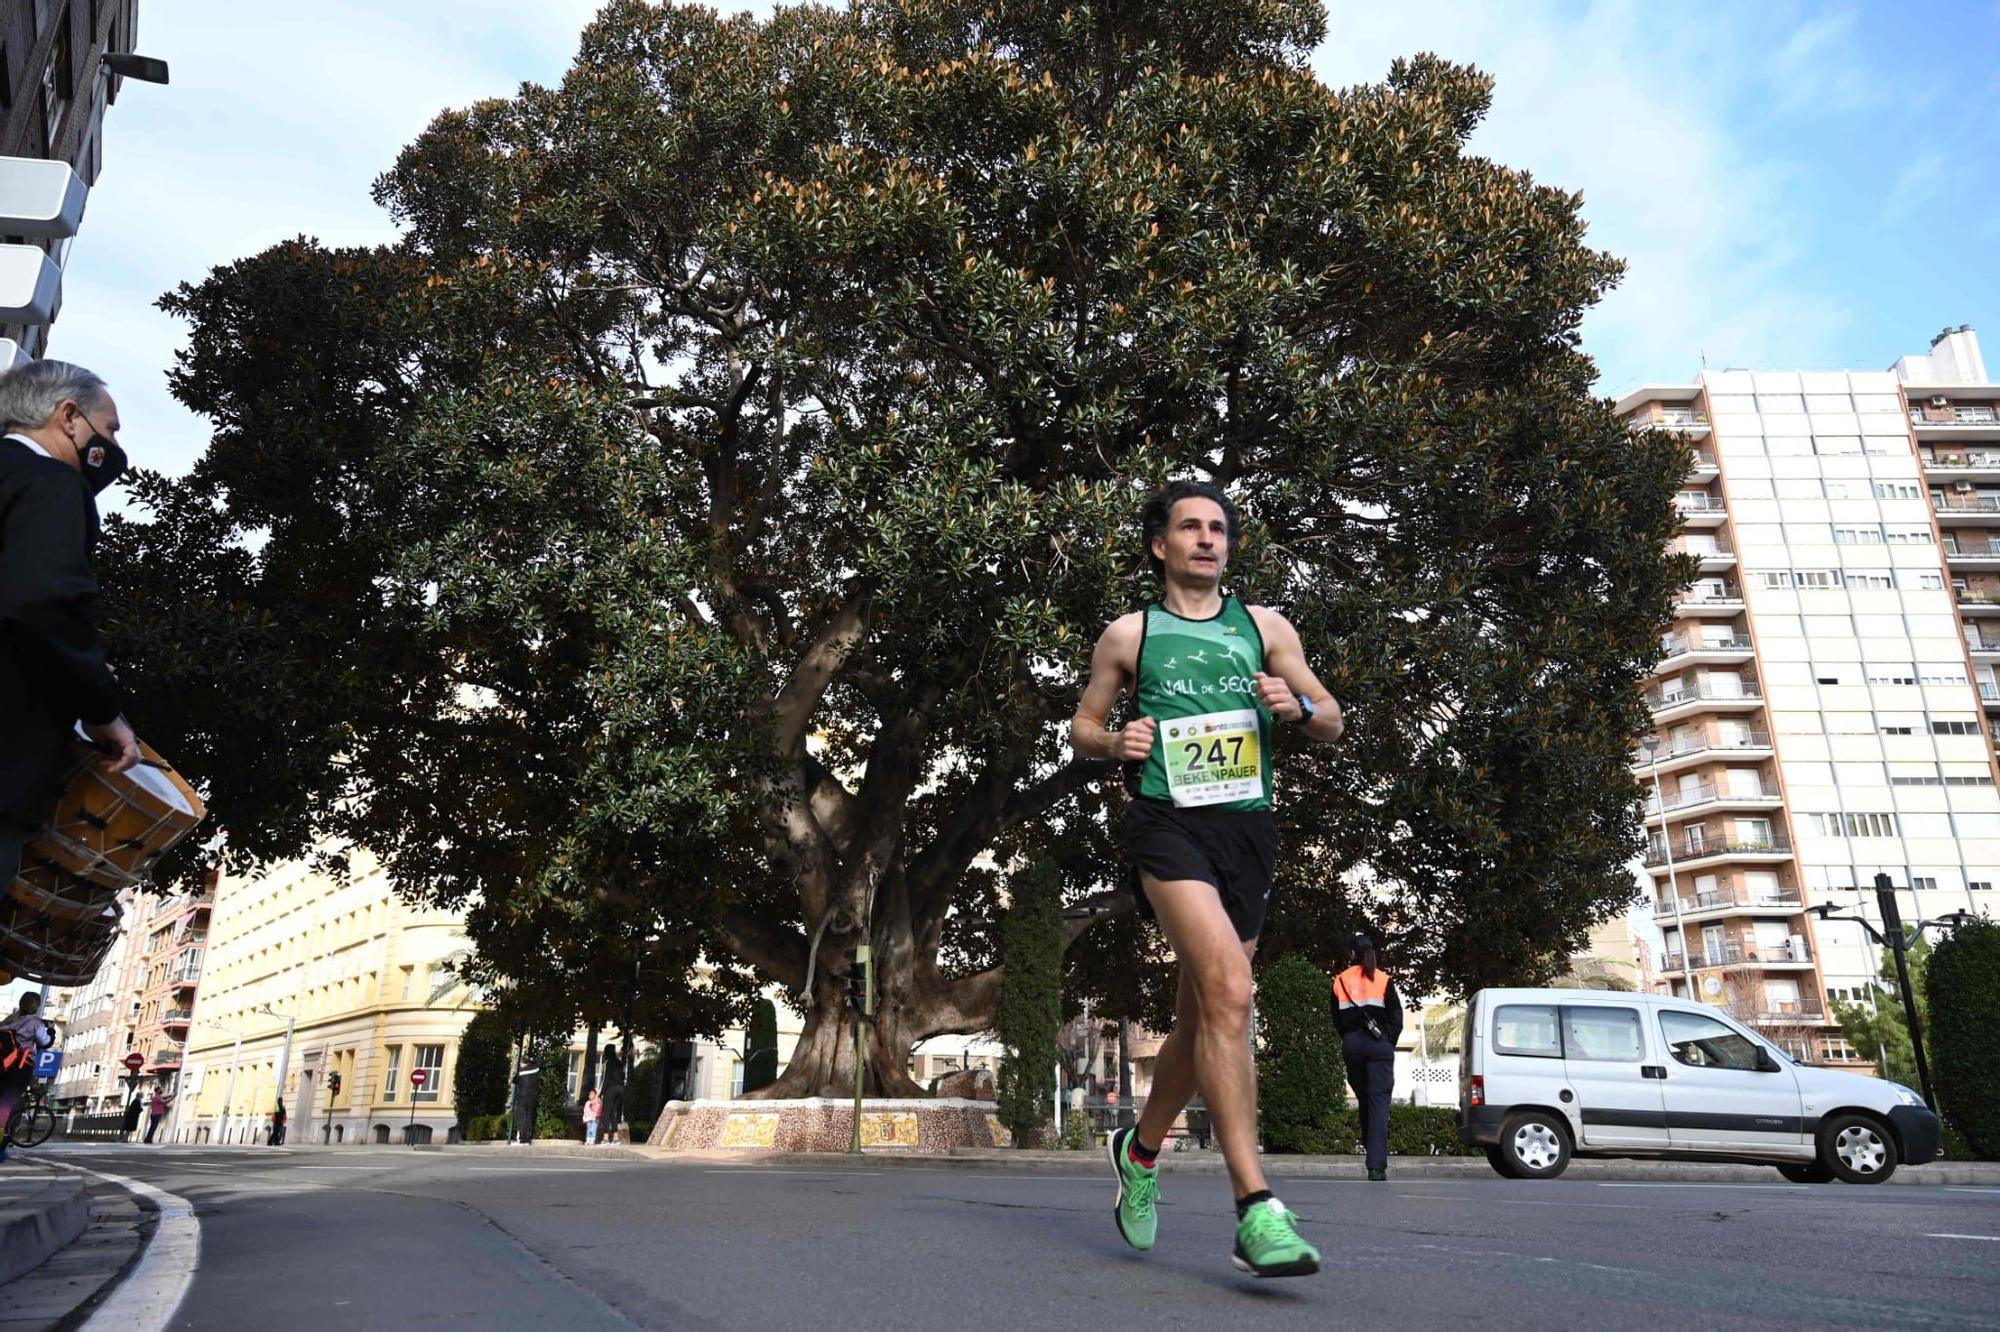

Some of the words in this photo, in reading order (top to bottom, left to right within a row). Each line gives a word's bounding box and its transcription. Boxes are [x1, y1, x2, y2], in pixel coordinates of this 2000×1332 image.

[1160, 679, 1198, 696] VALL
[1201, 684, 1215, 694] DE
[1184, 736, 1244, 772] 247
[1173, 765, 1258, 786] BEKENPAUER
[40, 1051, 55, 1067] P
